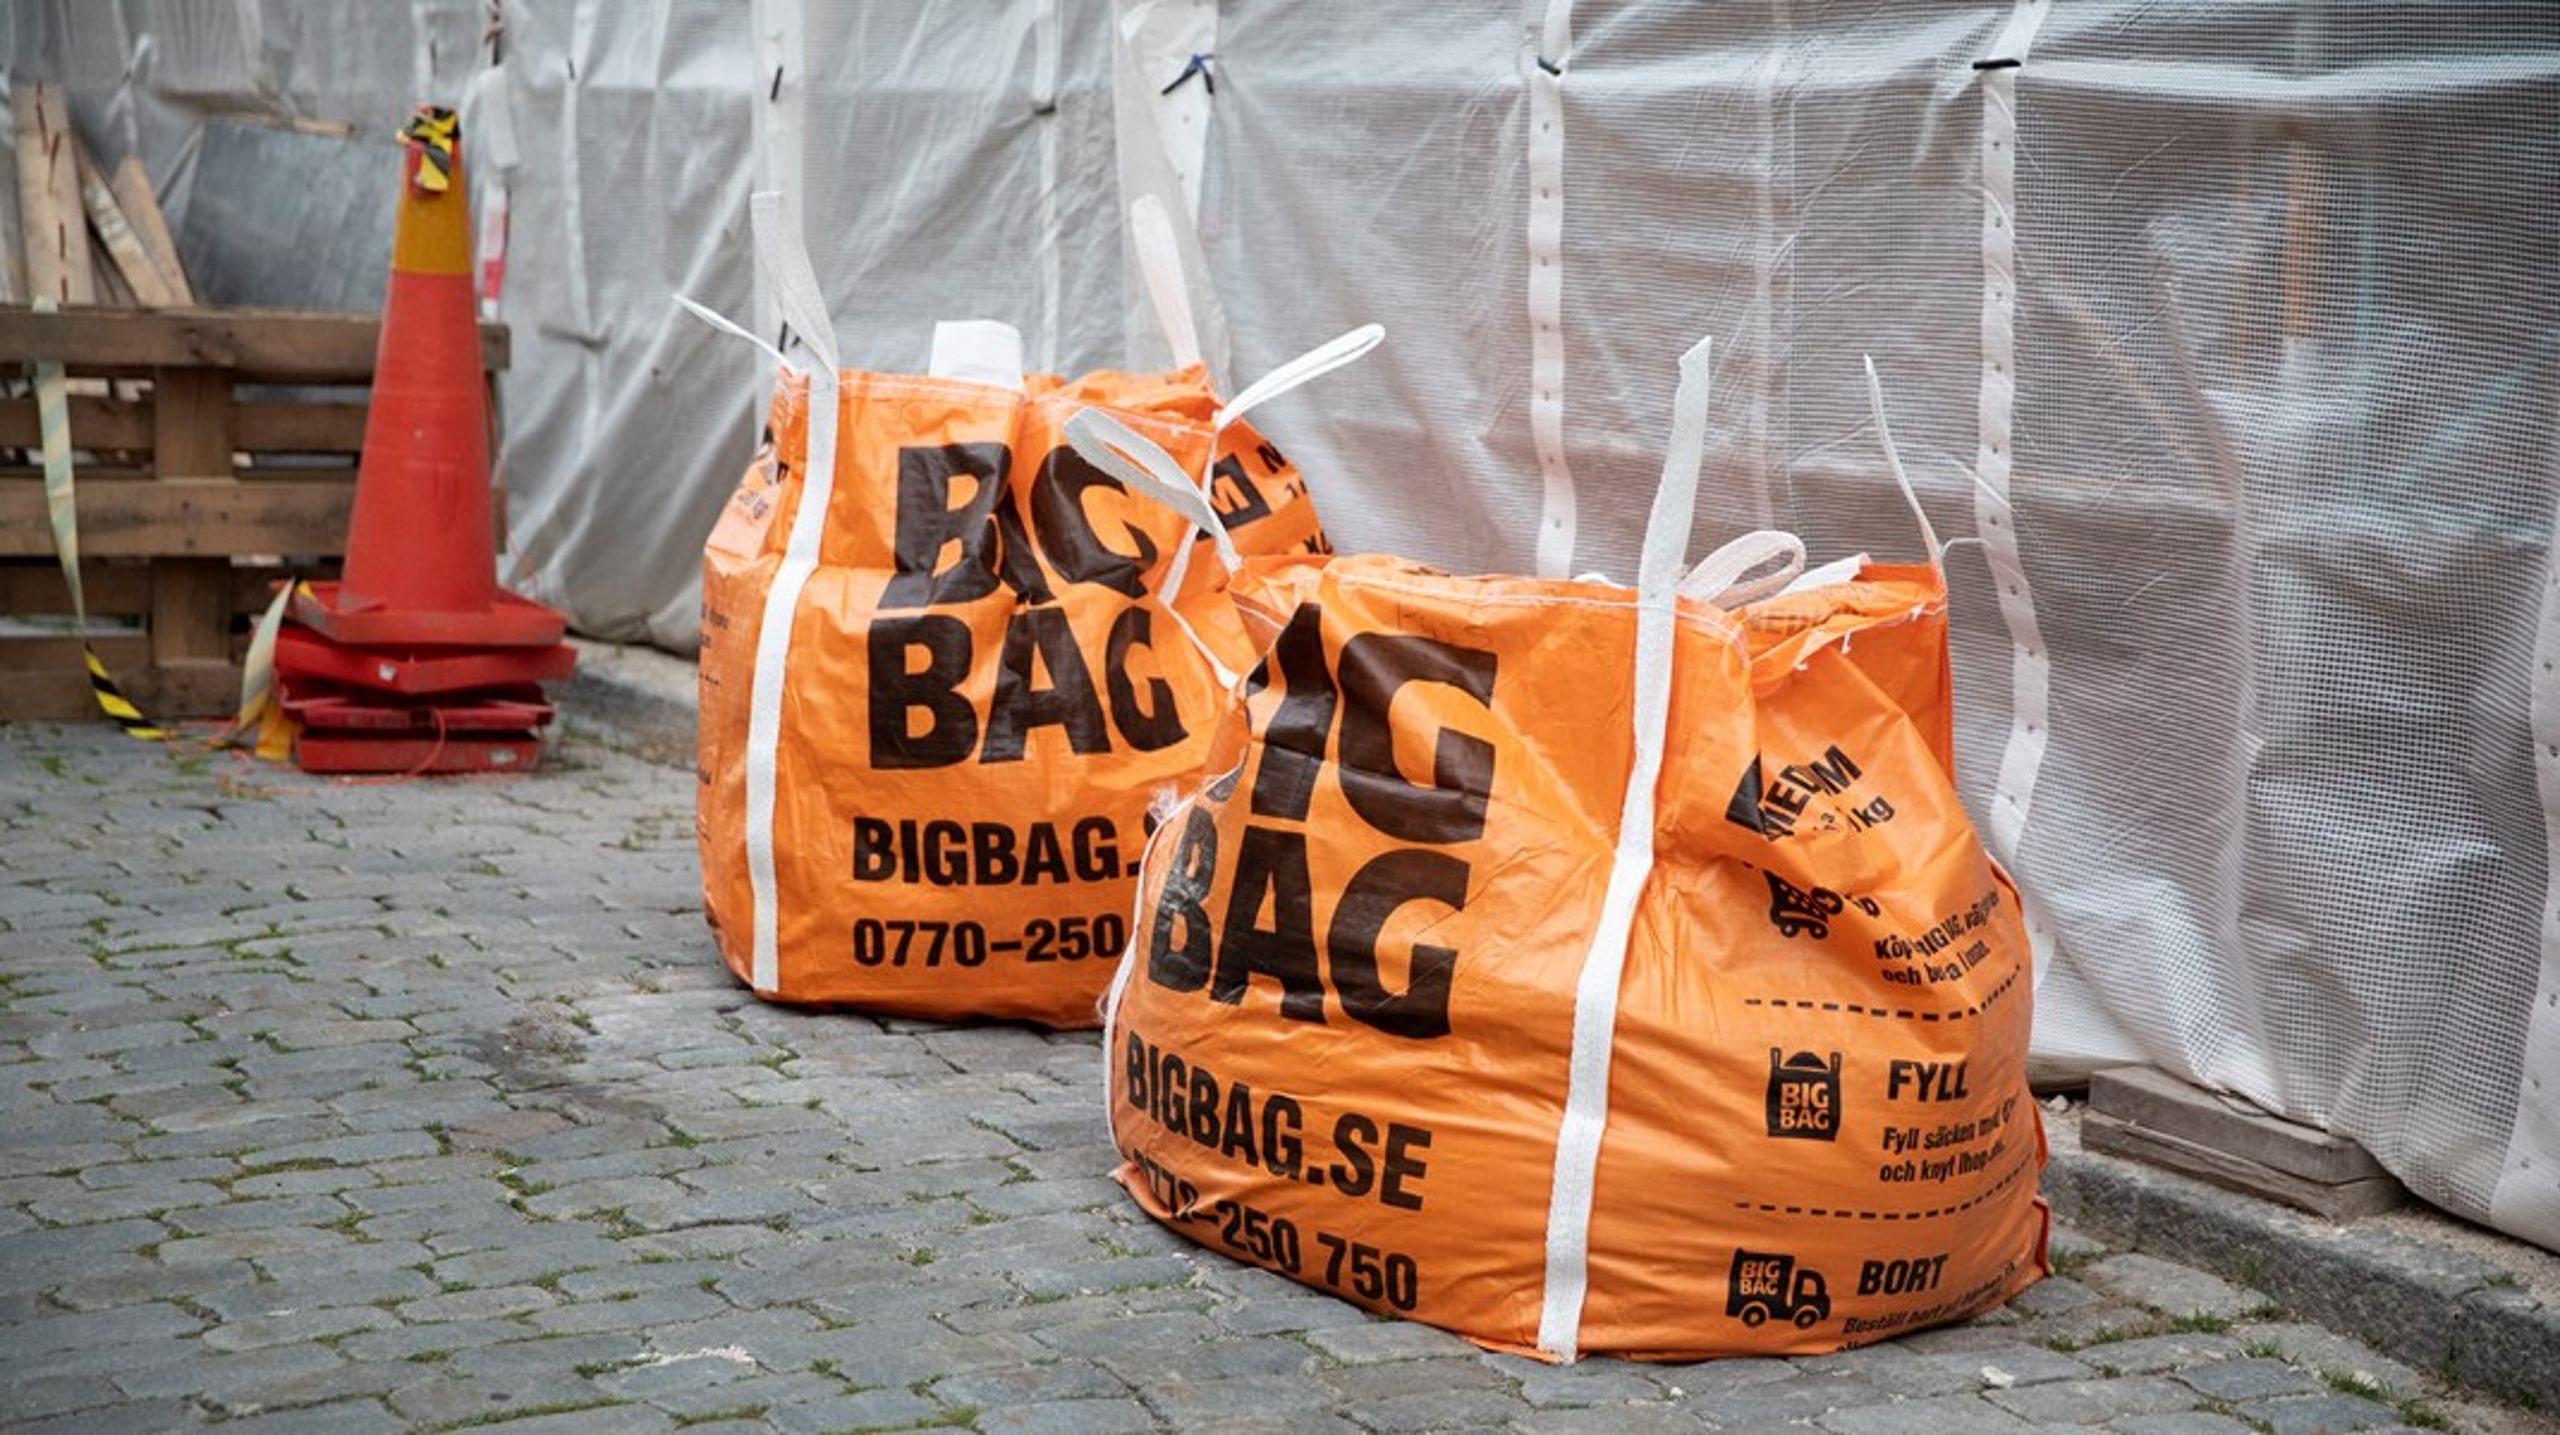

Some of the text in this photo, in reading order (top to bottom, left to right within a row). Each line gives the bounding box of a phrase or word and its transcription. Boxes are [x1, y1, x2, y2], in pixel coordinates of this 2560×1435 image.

[876, 441, 1149, 606] BIG
[866, 606, 1190, 771] BAG
[1147, 805, 1471, 1039] BAG
[1780, 1082, 1829, 1109] BIG
[1888, 1060, 1968, 1102] FYLL
[1126, 1029, 1433, 1212] BIGBAG.SE
[1779, 1108, 1830, 1130] BAG
[1882, 1126, 1920, 1155] Fyll
[1879, 1159, 1916, 1183] och
[1316, 1231, 1418, 1312] 750
[1738, 1278, 1779, 1297] BAG
[1740, 1260, 1782, 1279] BIG
[1857, 1253, 1949, 1296] BORT
